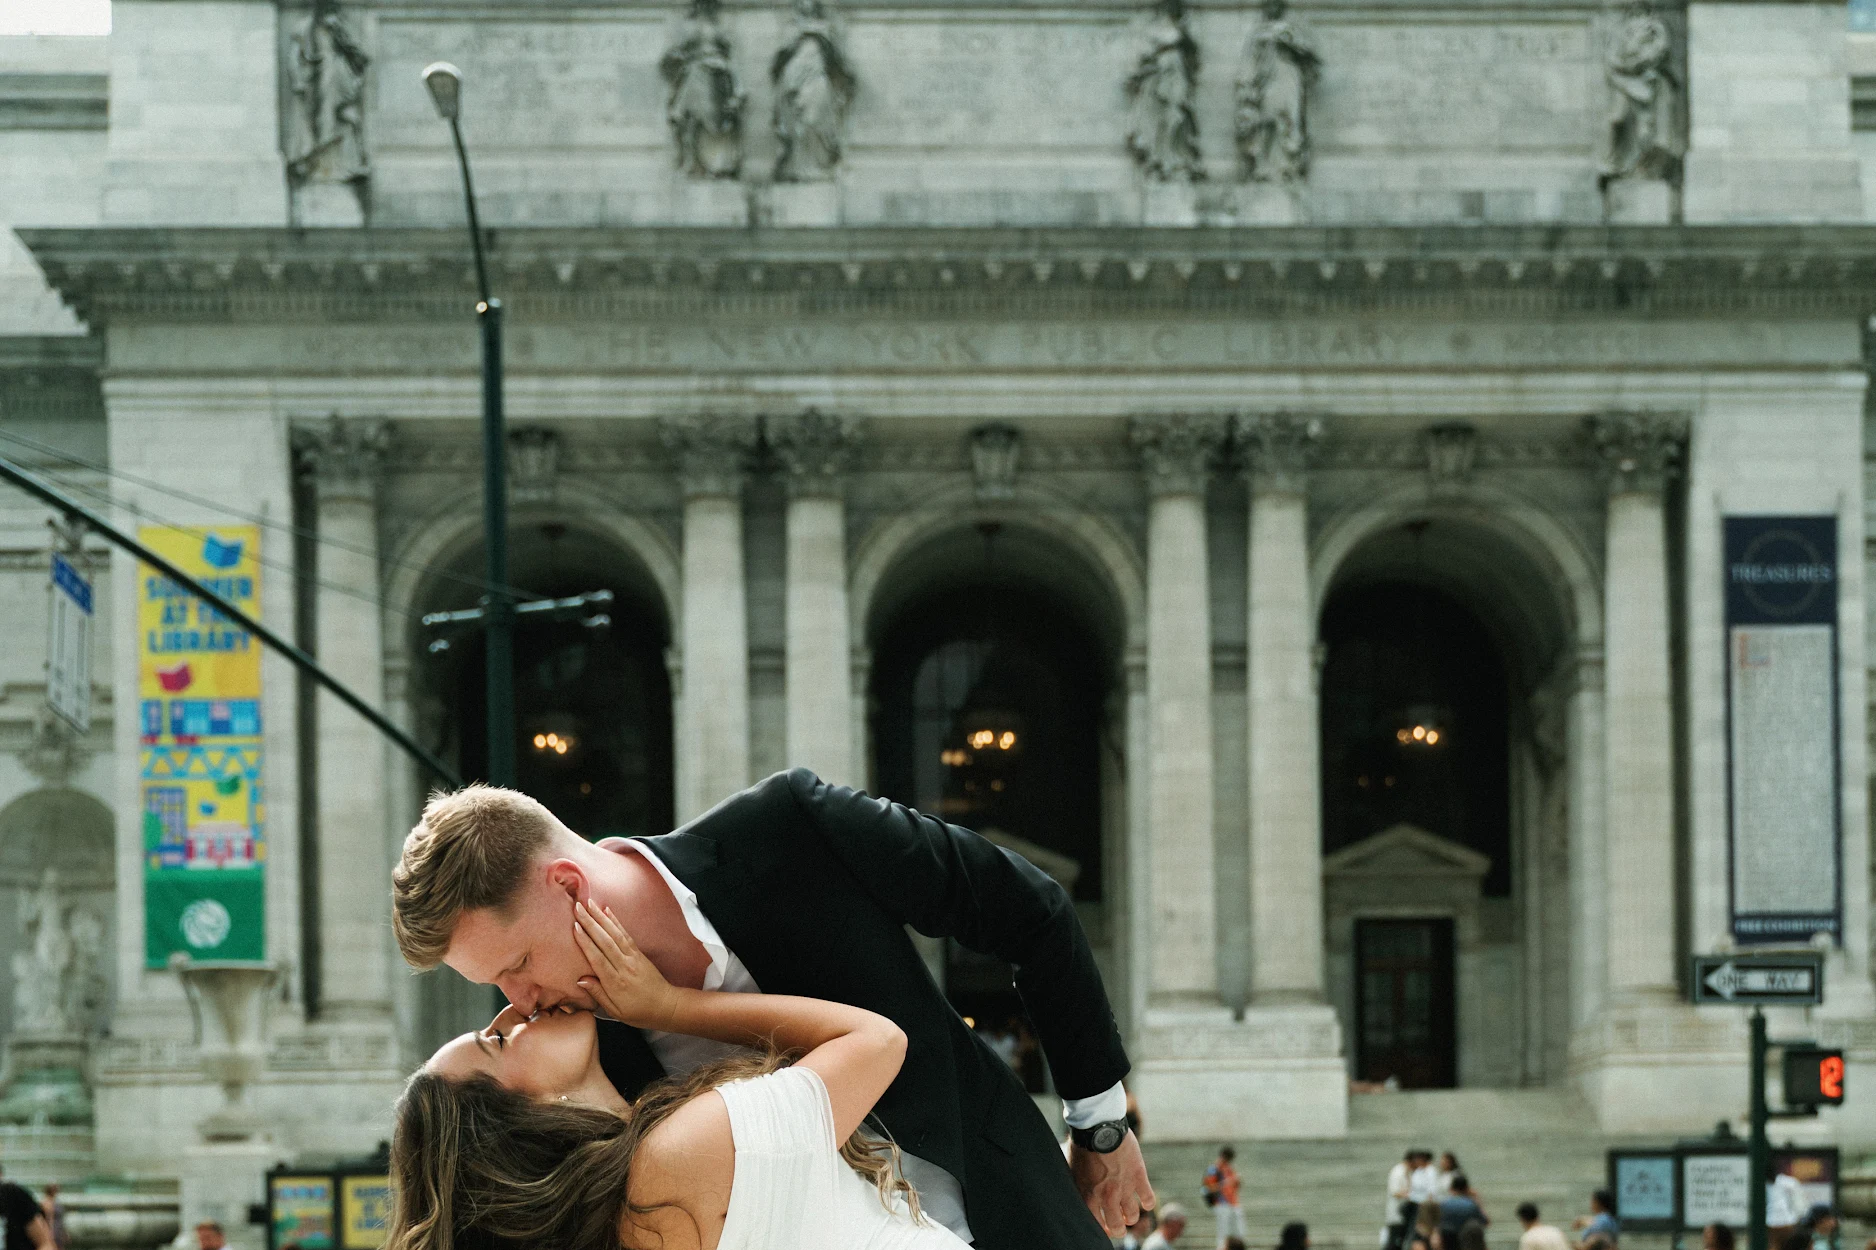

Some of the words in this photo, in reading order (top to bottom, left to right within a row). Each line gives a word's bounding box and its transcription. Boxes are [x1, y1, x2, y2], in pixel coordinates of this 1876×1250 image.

[575, 327, 672, 363] THE
[706, 326, 819, 362] NEW
[861, 327, 983, 362] YORK
[1223, 326, 1413, 362] LIBRARY
[1718, 973, 1748, 990] ONE
[1765, 972, 1799, 990] WAY
